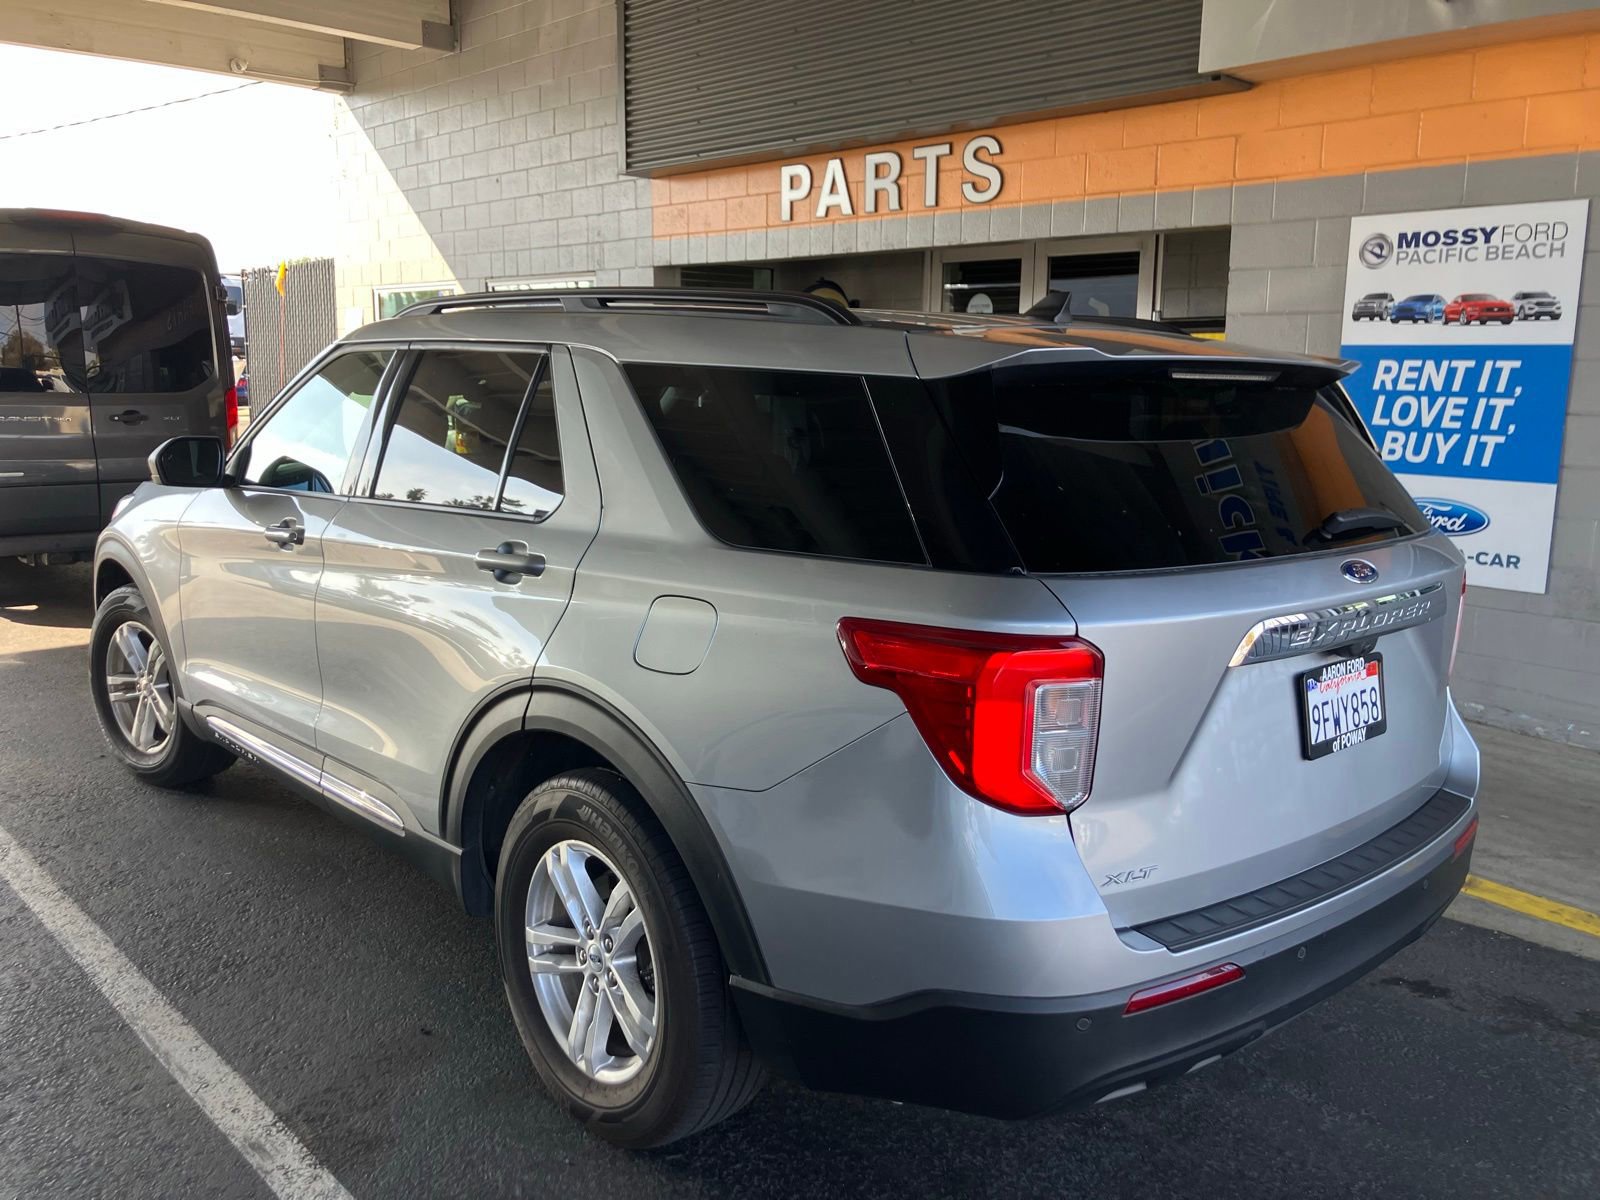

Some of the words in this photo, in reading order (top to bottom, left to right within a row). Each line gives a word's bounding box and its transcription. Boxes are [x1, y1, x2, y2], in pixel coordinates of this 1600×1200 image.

[780, 135, 1003, 222] PARTS
[1397, 226, 1498, 249] MOSSY
[1501, 221, 1569, 243] FORD
[1396, 246, 1479, 266] PACIFIC
[1485, 242, 1566, 261] BEACH
[1372, 359, 1476, 392] RENT
[1477, 360, 1523, 397] IT,
[1371, 394, 1468, 428] LOVE
[1471, 397, 1516, 435] IT,
[1382, 430, 1461, 464] BUY
[1462, 434, 1506, 467] IT
[1460, 549, 1521, 569] -CAR
[1290, 600, 1432, 646] EXPLORER
[1322, 662, 1346, 681] AARON
[1347, 657, 1365, 674] FORD
[1312, 687, 1379, 743] 9FWY858
[1332, 735, 1341, 752] of
[1342, 727, 1367, 748] POWAY
[1100, 864, 1160, 887] XLT
